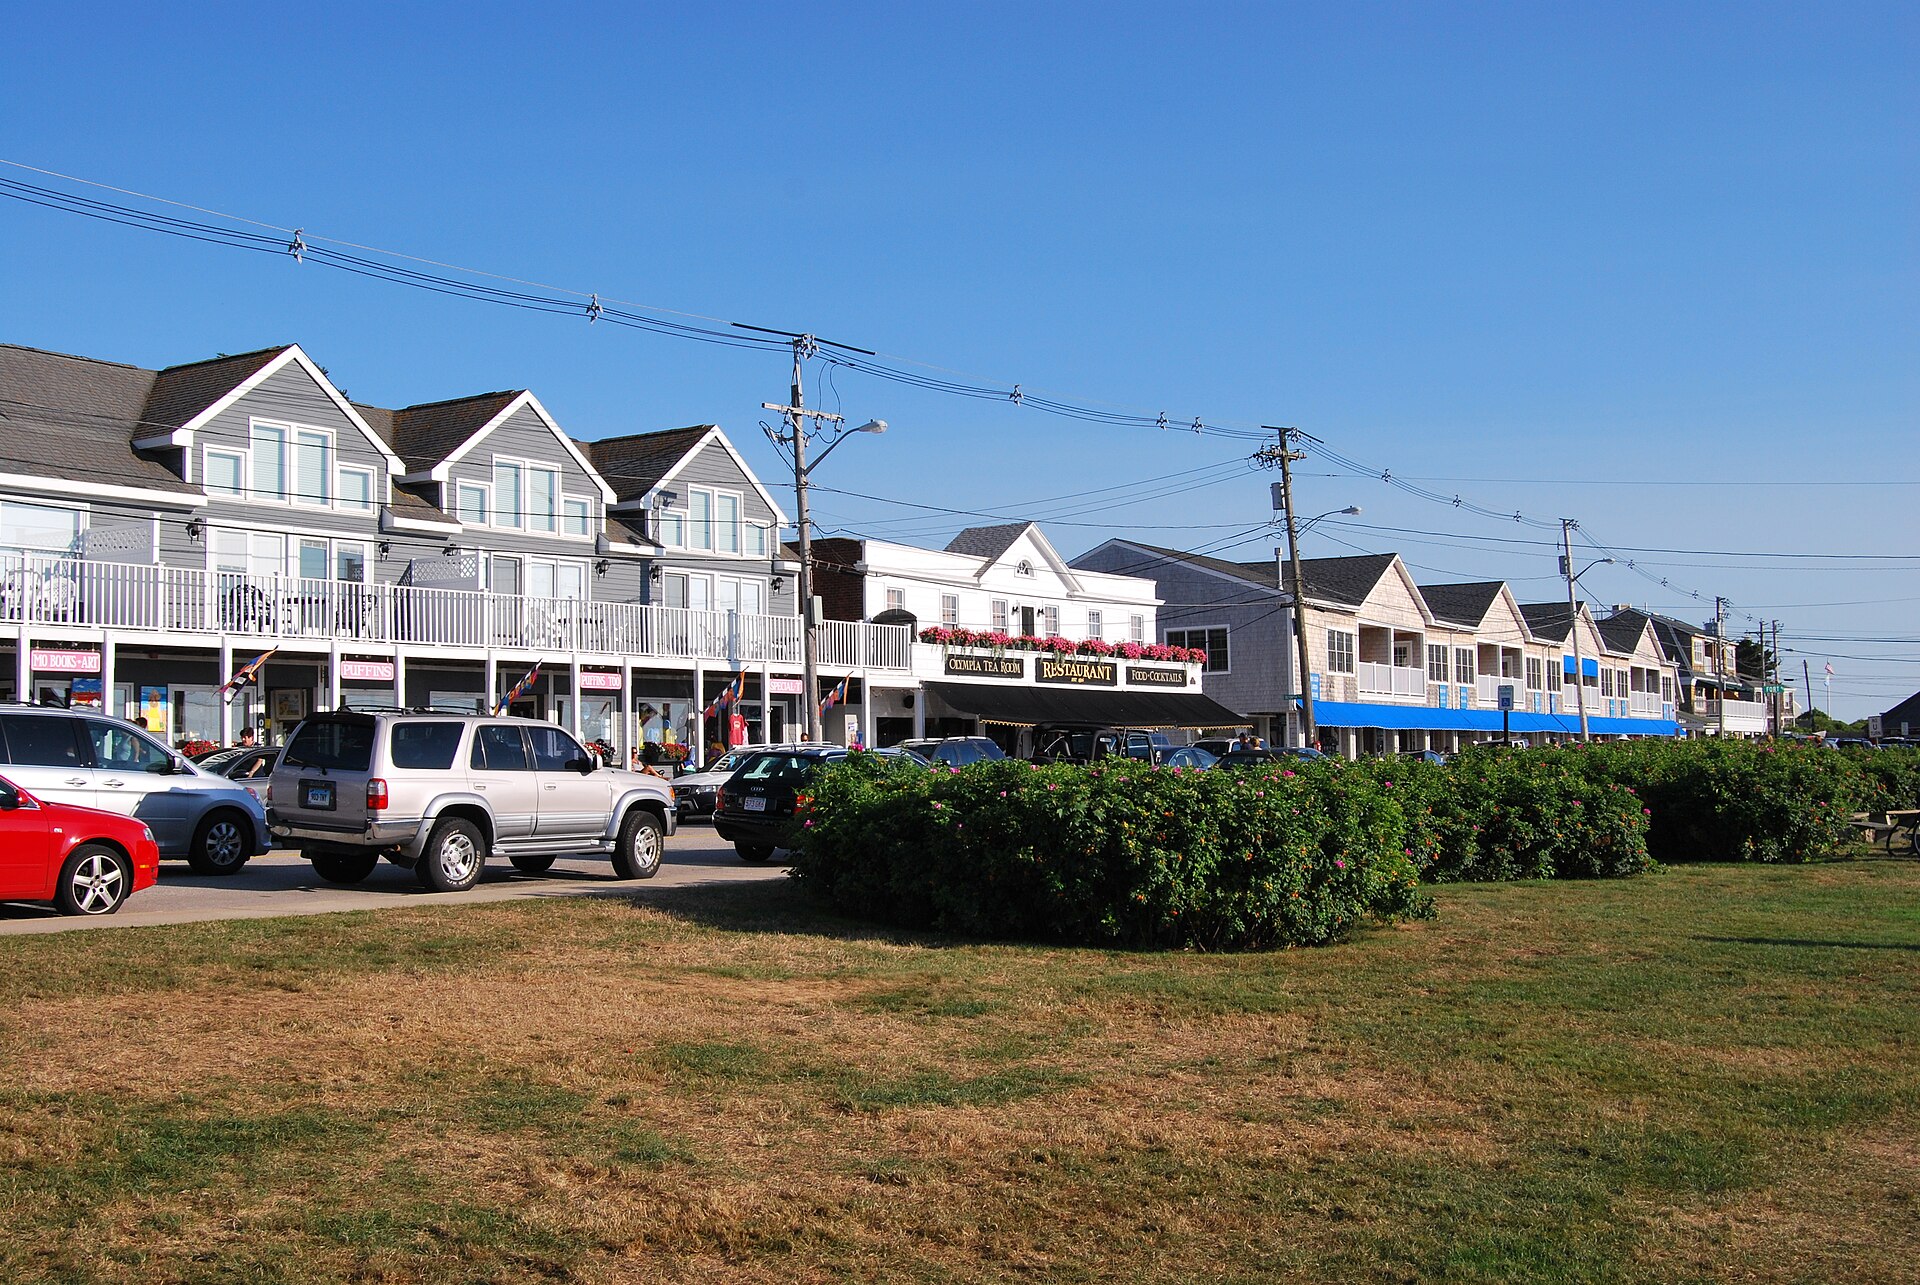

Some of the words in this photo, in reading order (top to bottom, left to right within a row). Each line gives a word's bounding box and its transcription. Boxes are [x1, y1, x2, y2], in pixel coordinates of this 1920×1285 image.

[33, 654, 48, 667] MO
[949, 658, 982, 671] OLYMPIA
[983, 660, 999, 672] TEA
[1000, 661, 1021, 674] ROOM
[343, 664, 392, 678] PUFFINS
[1042, 661, 1112, 681] RESTAURANT
[581, 675, 606, 686] PUFFINS
[607, 676, 620, 687] TOO
[1872, 723, 1878, 731] U
